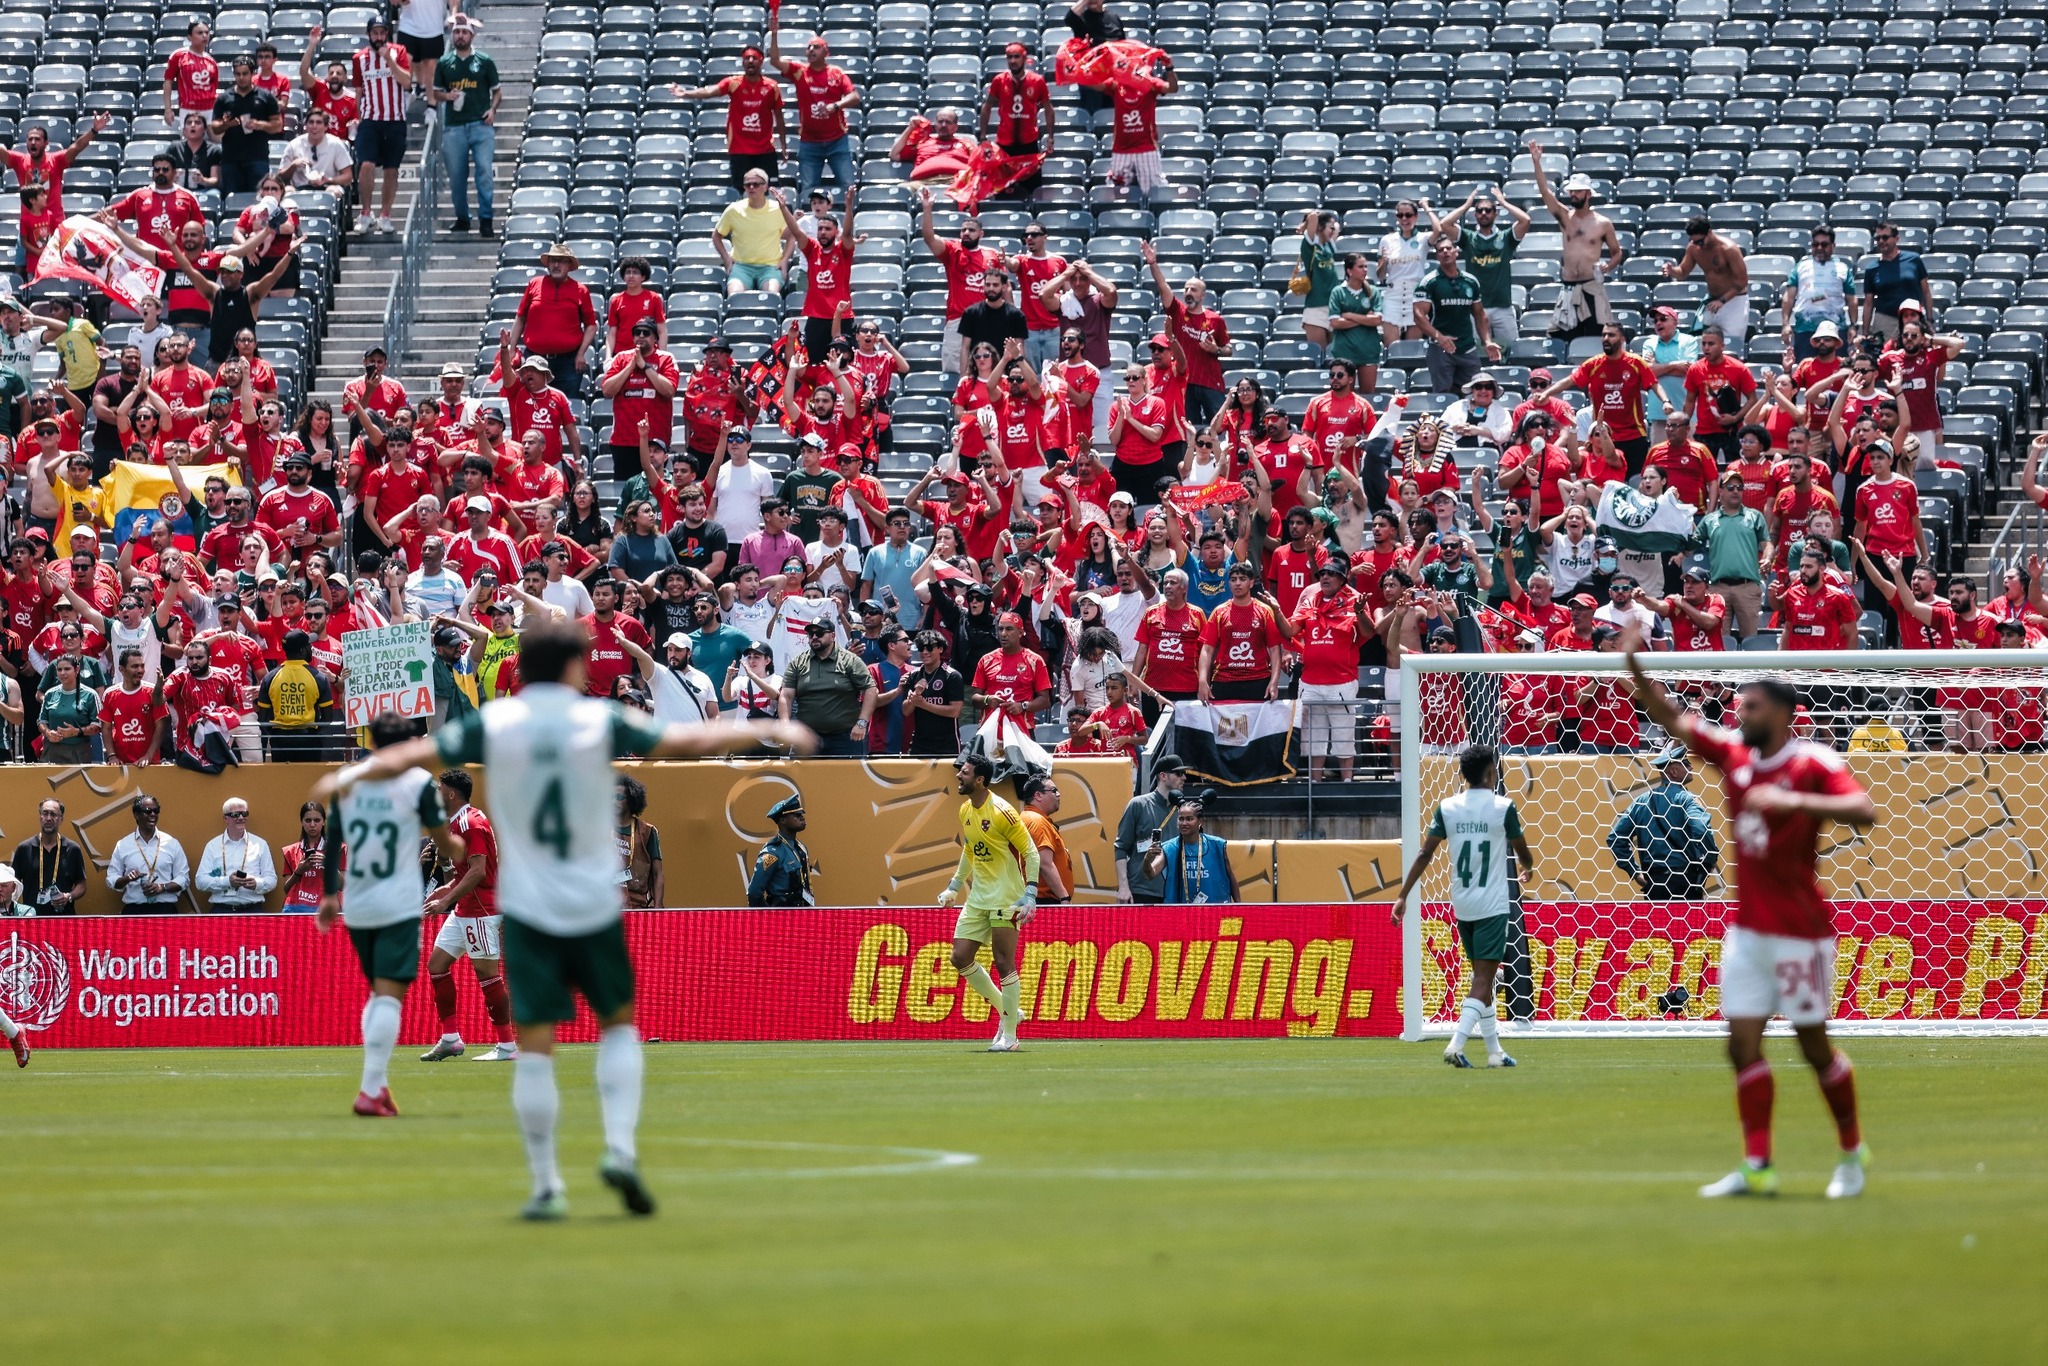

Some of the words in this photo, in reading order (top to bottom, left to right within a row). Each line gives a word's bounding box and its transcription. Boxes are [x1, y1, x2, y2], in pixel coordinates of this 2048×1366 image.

[1274, 453, 1287, 468] 10
[1560, 556, 1592, 569] crefisa
[1625, 551, 1655, 563] crefisa
[1290, 572, 1304, 588] 10
[342, 630, 371, 643] HOJE
[390, 625, 402, 637] O
[404, 621, 430, 636] MEU
[345, 652, 371, 668] POR
[376, 660, 403, 672] PODE
[348, 675, 363, 687] ME
[365, 671, 390, 684] DAR
[394, 669, 402, 681] A
[280, 682, 306, 692] CSC
[349, 685, 371, 698] SUA
[372, 680, 407, 692] CAMISA
[280, 693, 306, 704] EVENT
[280, 704, 306, 716] STAFF
[533, 777, 573, 862] 4
[1456, 820, 1489, 834] ESTÊVÃO
[347, 818, 400, 881] 23
[304, 866, 317, 877] 103
[1185, 861, 1205, 869] FIFA
[1455, 840, 1492, 890] 41
[465, 925, 477, 946] 6
[78, 946, 167, 981] World
[179, 945, 279, 980] Health
[1018, 916, 1374, 1038] moving.
[78, 985, 280, 1028] Organization
